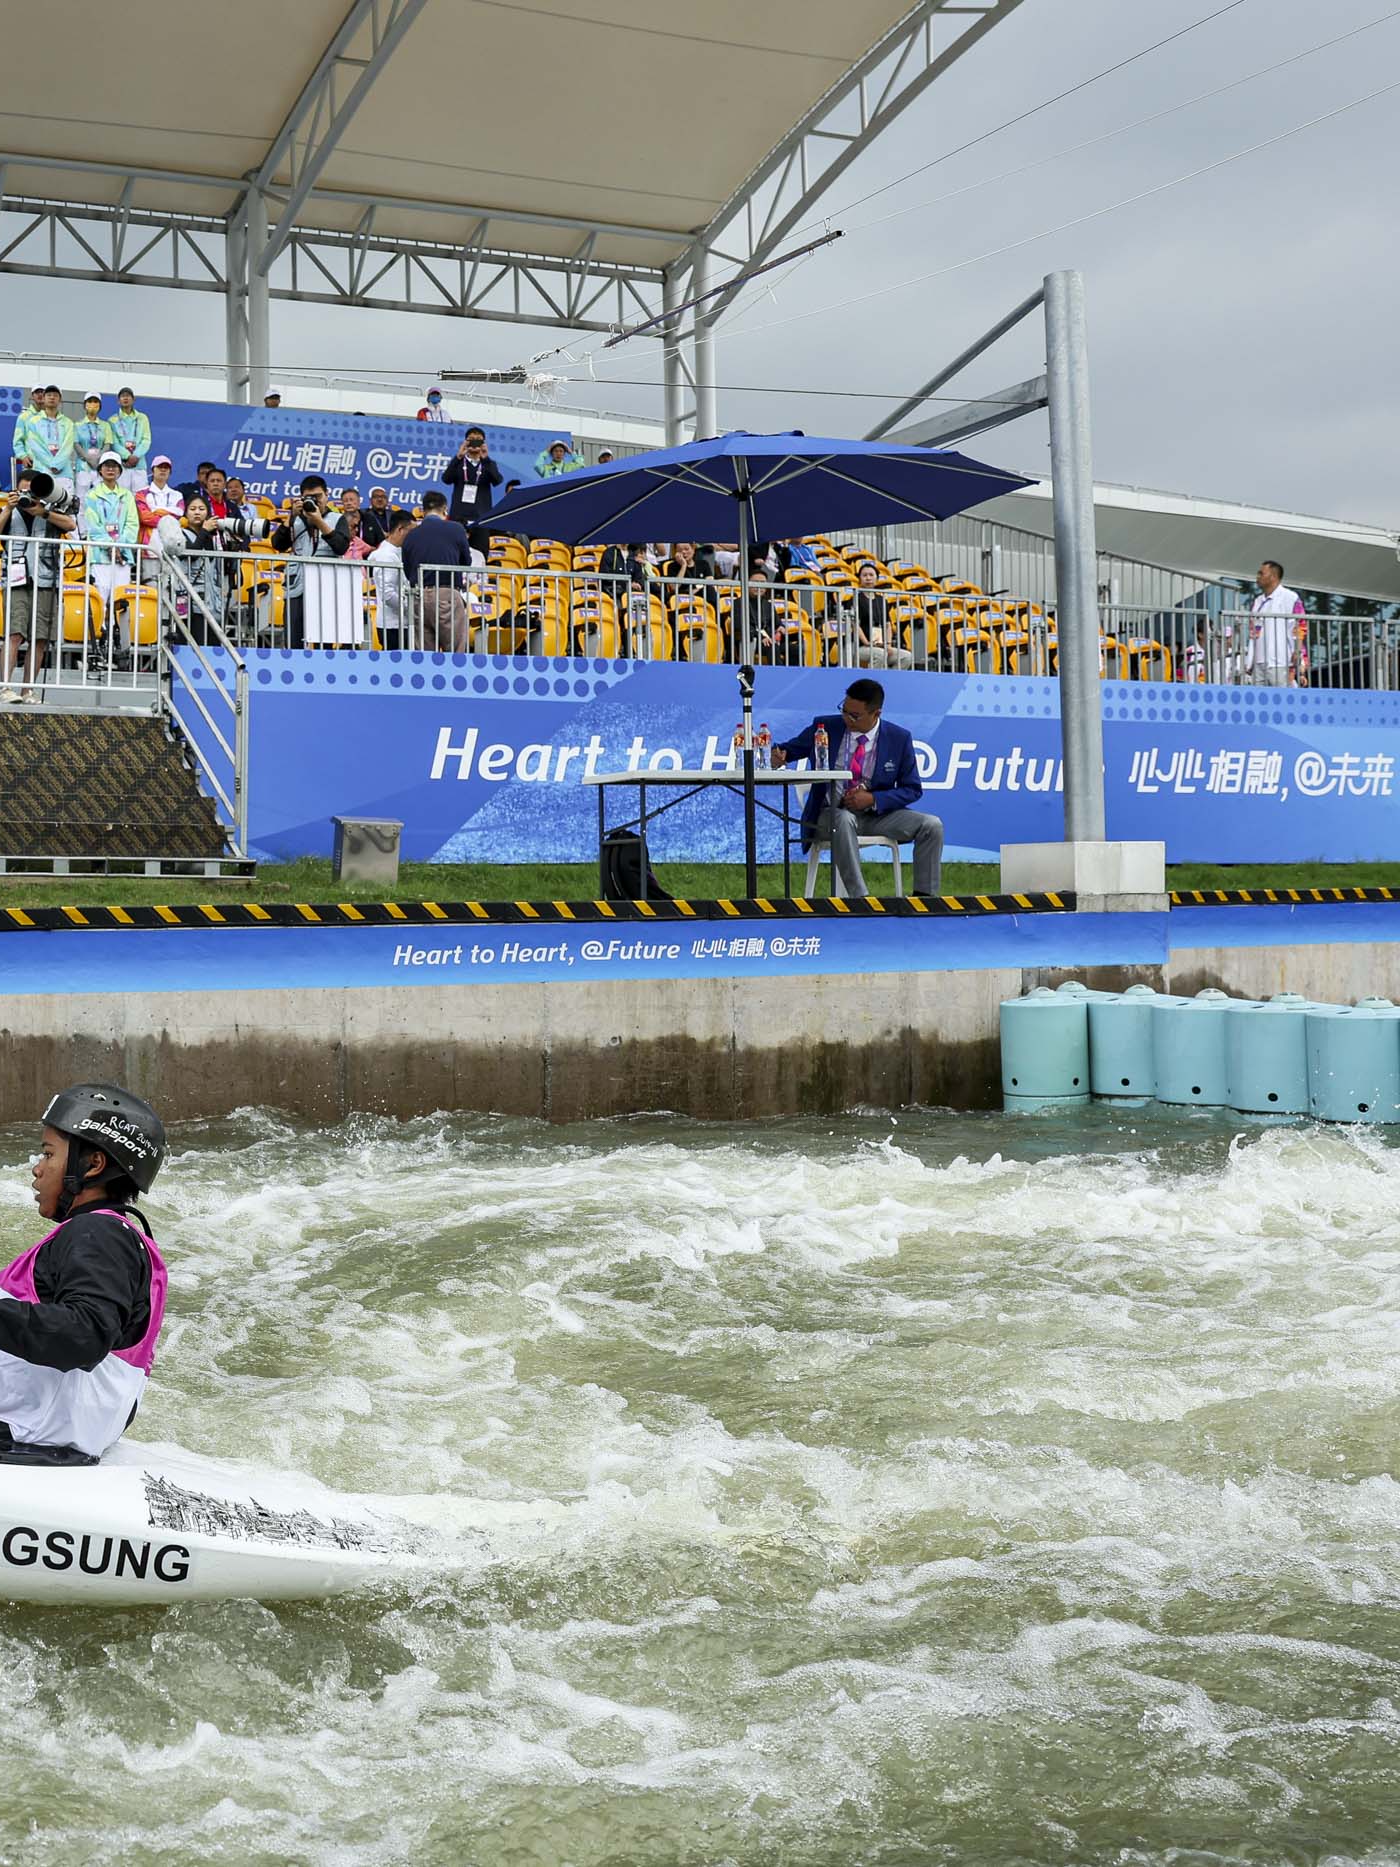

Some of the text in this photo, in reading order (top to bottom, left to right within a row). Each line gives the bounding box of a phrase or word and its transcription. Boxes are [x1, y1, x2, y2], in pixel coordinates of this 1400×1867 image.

[430, 727, 604, 783] Heart
[625, 737, 683, 771] to
[393, 940, 680, 966] Heart to Heart, @Future
